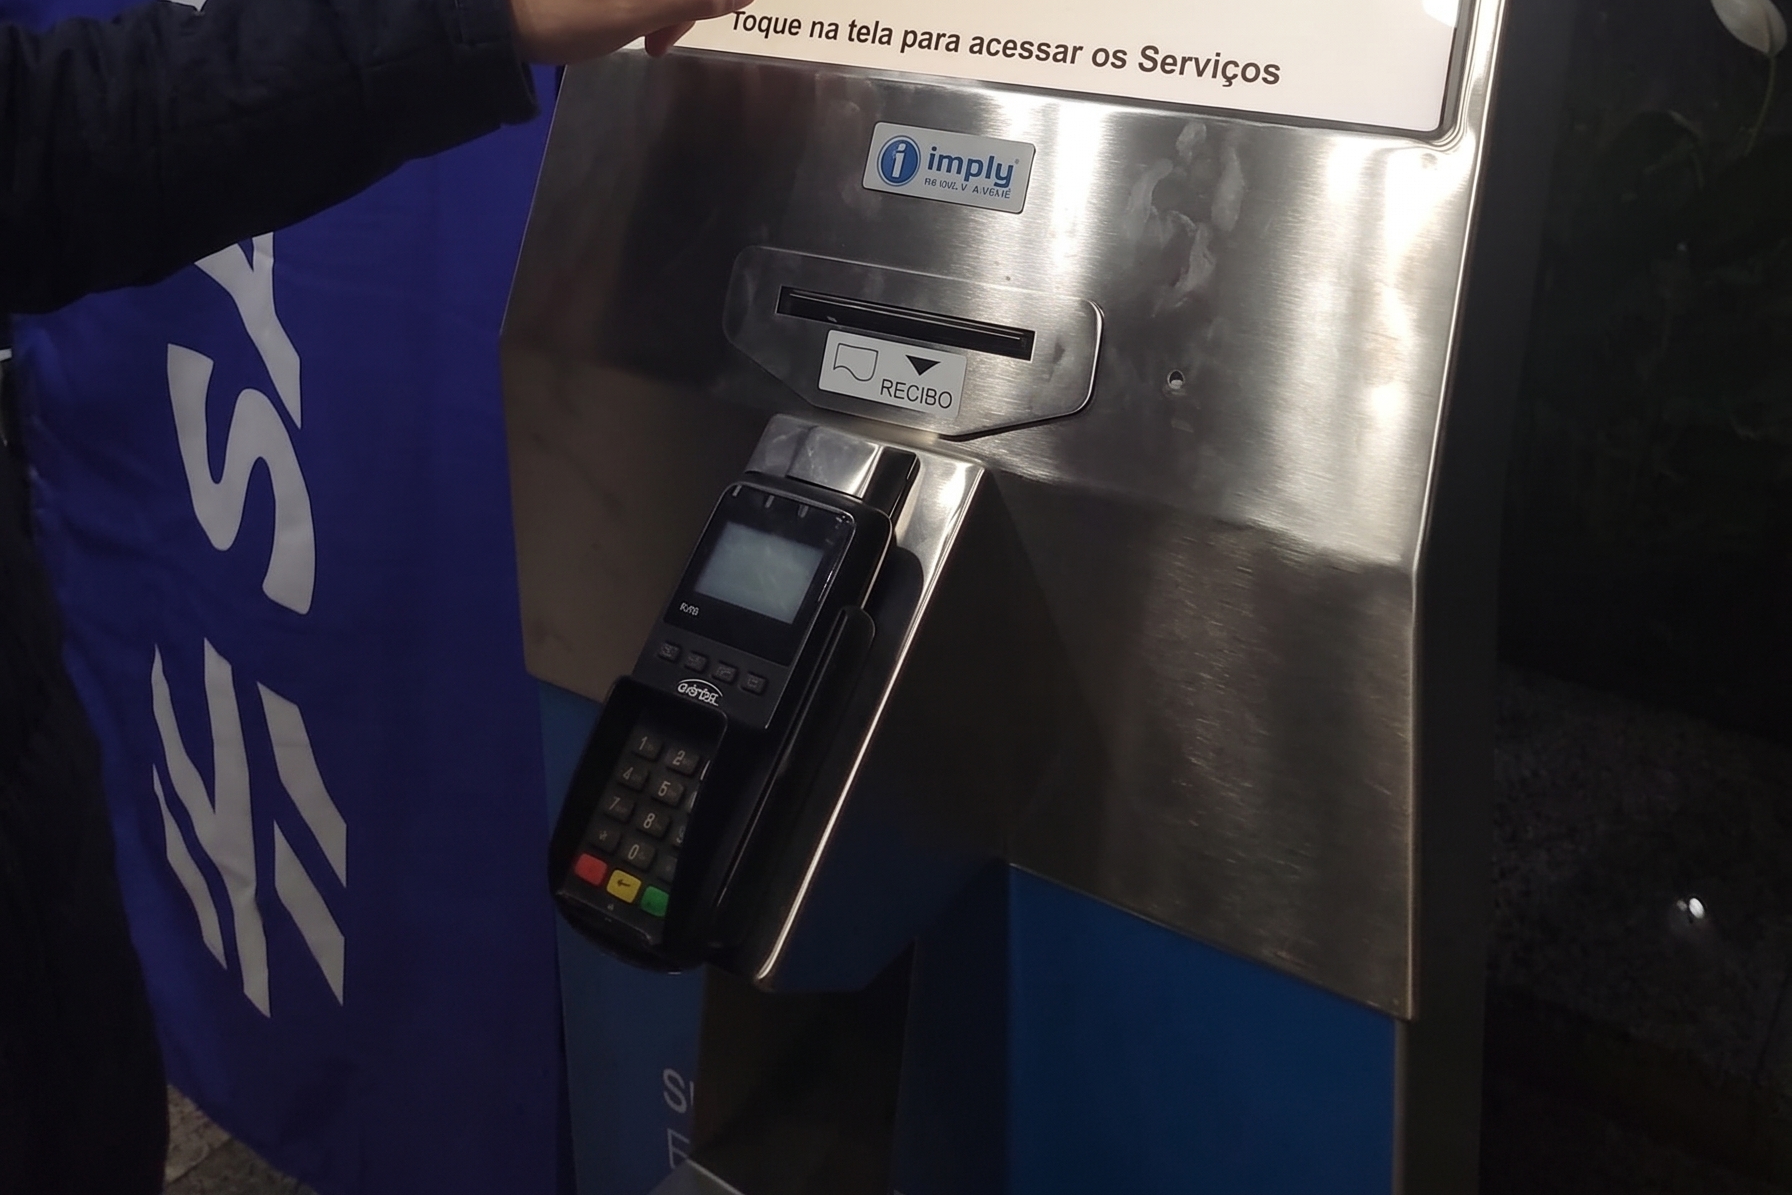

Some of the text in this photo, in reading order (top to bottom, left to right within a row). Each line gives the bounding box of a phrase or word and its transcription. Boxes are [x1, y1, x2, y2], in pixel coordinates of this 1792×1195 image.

[731, 10, 1281, 88] Toque na tela para acessar os Serviços
[927, 146, 1014, 189] imply
[880, 378, 953, 409] RECIBO
[672, 749, 686, 766] 2
[642, 812, 656, 829] 8
[627, 843, 640, 860] 0
